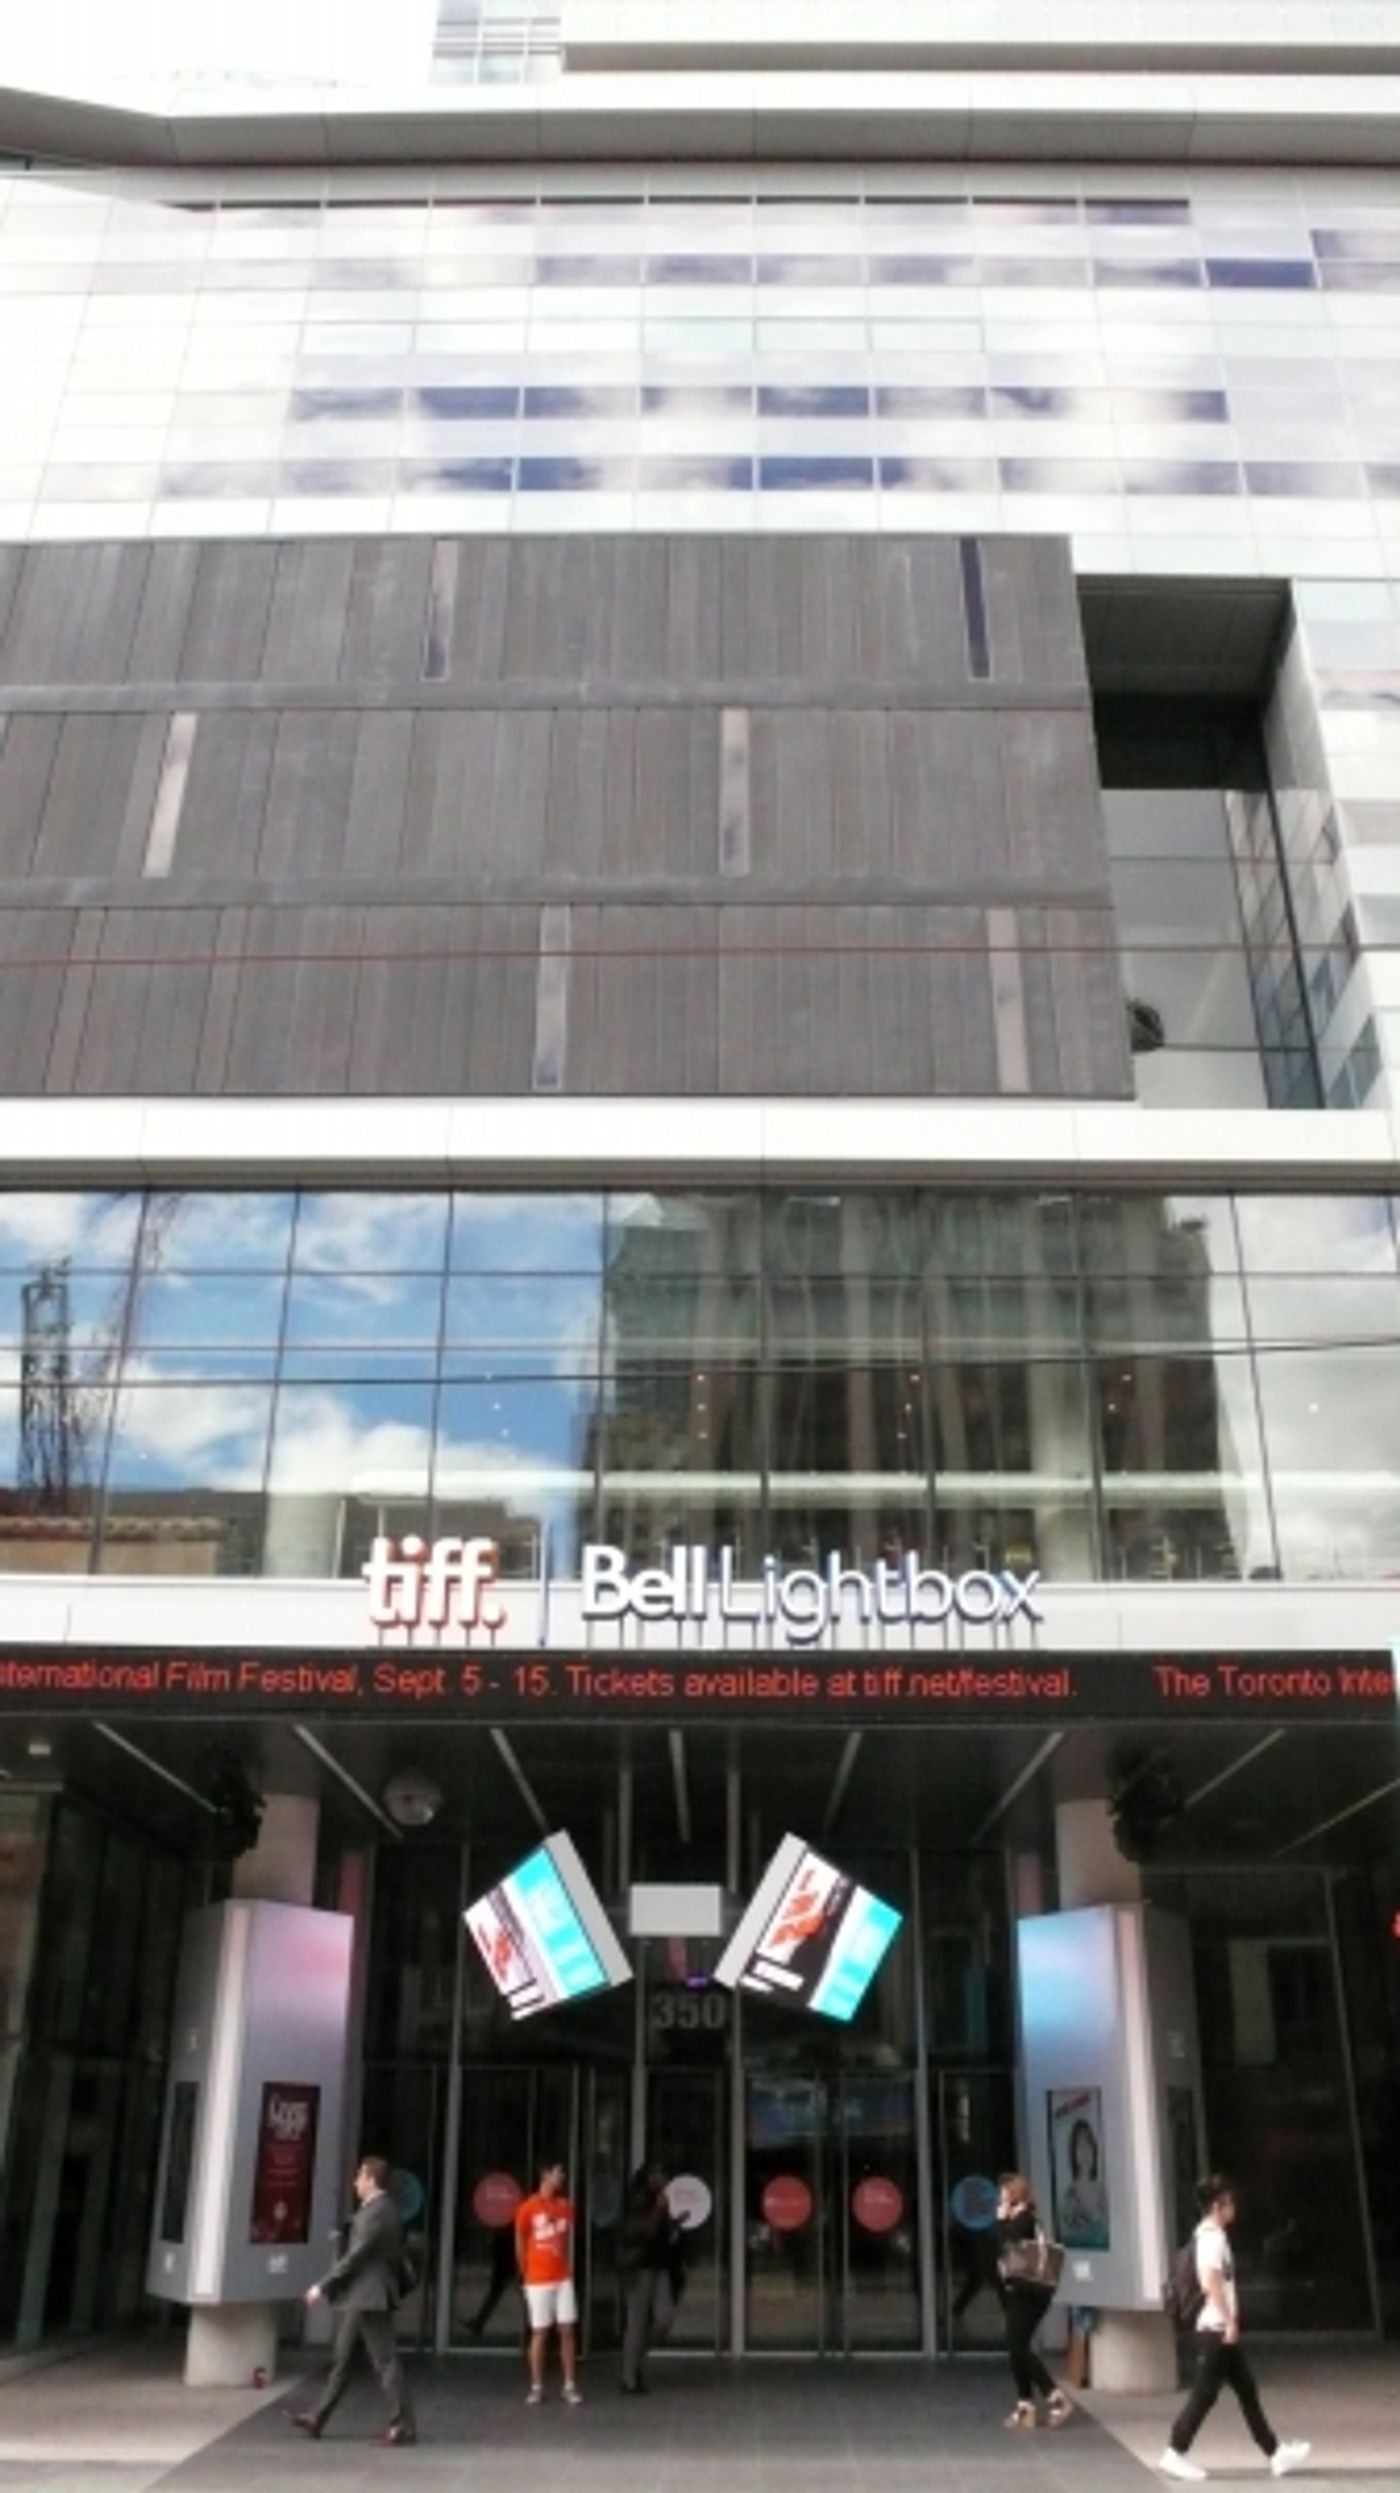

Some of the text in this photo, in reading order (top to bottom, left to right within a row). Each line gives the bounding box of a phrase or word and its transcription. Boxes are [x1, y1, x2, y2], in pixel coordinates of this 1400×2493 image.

[361, 1535, 506, 1628] tiff.
[582, 1544, 1043, 1645] Bell Lightbox
[166, 1661, 230, 1691] Film
[239, 1662, 362, 1696] Festival,
[461, 1664, 481, 1695] 5
[565, 1665, 675, 1698] Tickets
[683, 1667, 818, 1697] available
[827, 1670, 857, 1697] at
[1154, 1665, 1211, 1696] The
[1217, 1665, 1331, 1696] Toronto
[652, 1993, 726, 2029] 350
